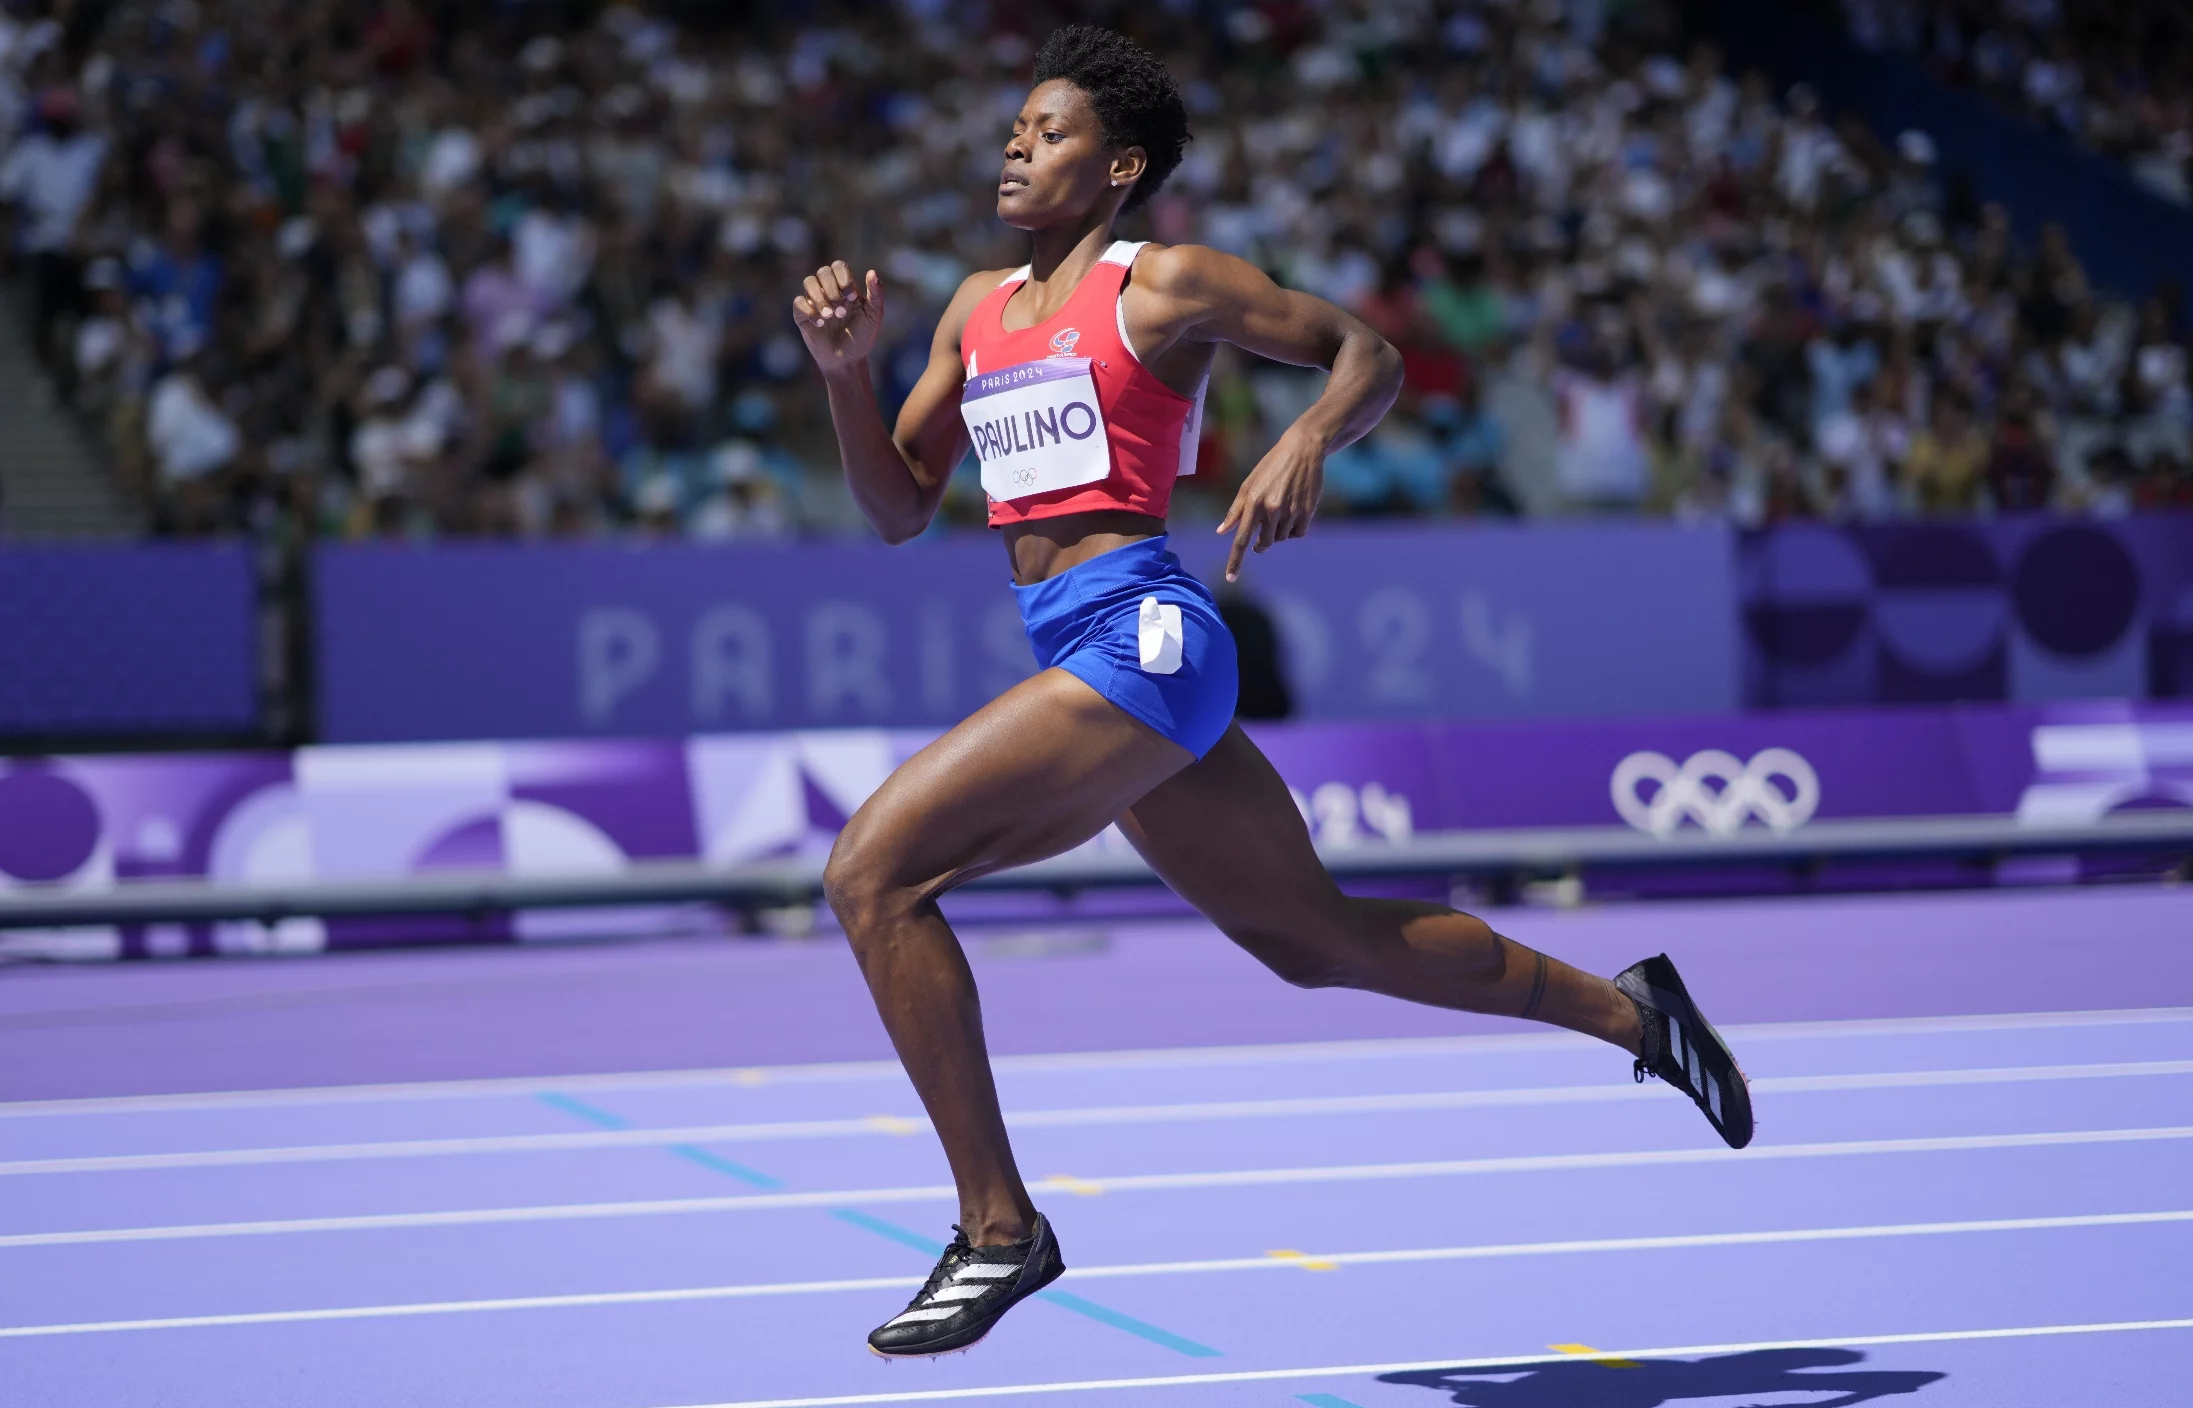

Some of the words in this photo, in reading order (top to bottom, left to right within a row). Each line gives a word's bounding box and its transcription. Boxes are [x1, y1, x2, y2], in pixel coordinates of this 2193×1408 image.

[1012, 366, 1043, 382] 2024
[973, 401, 1097, 462] PAULINO
[1289, 780, 1413, 850] 24
